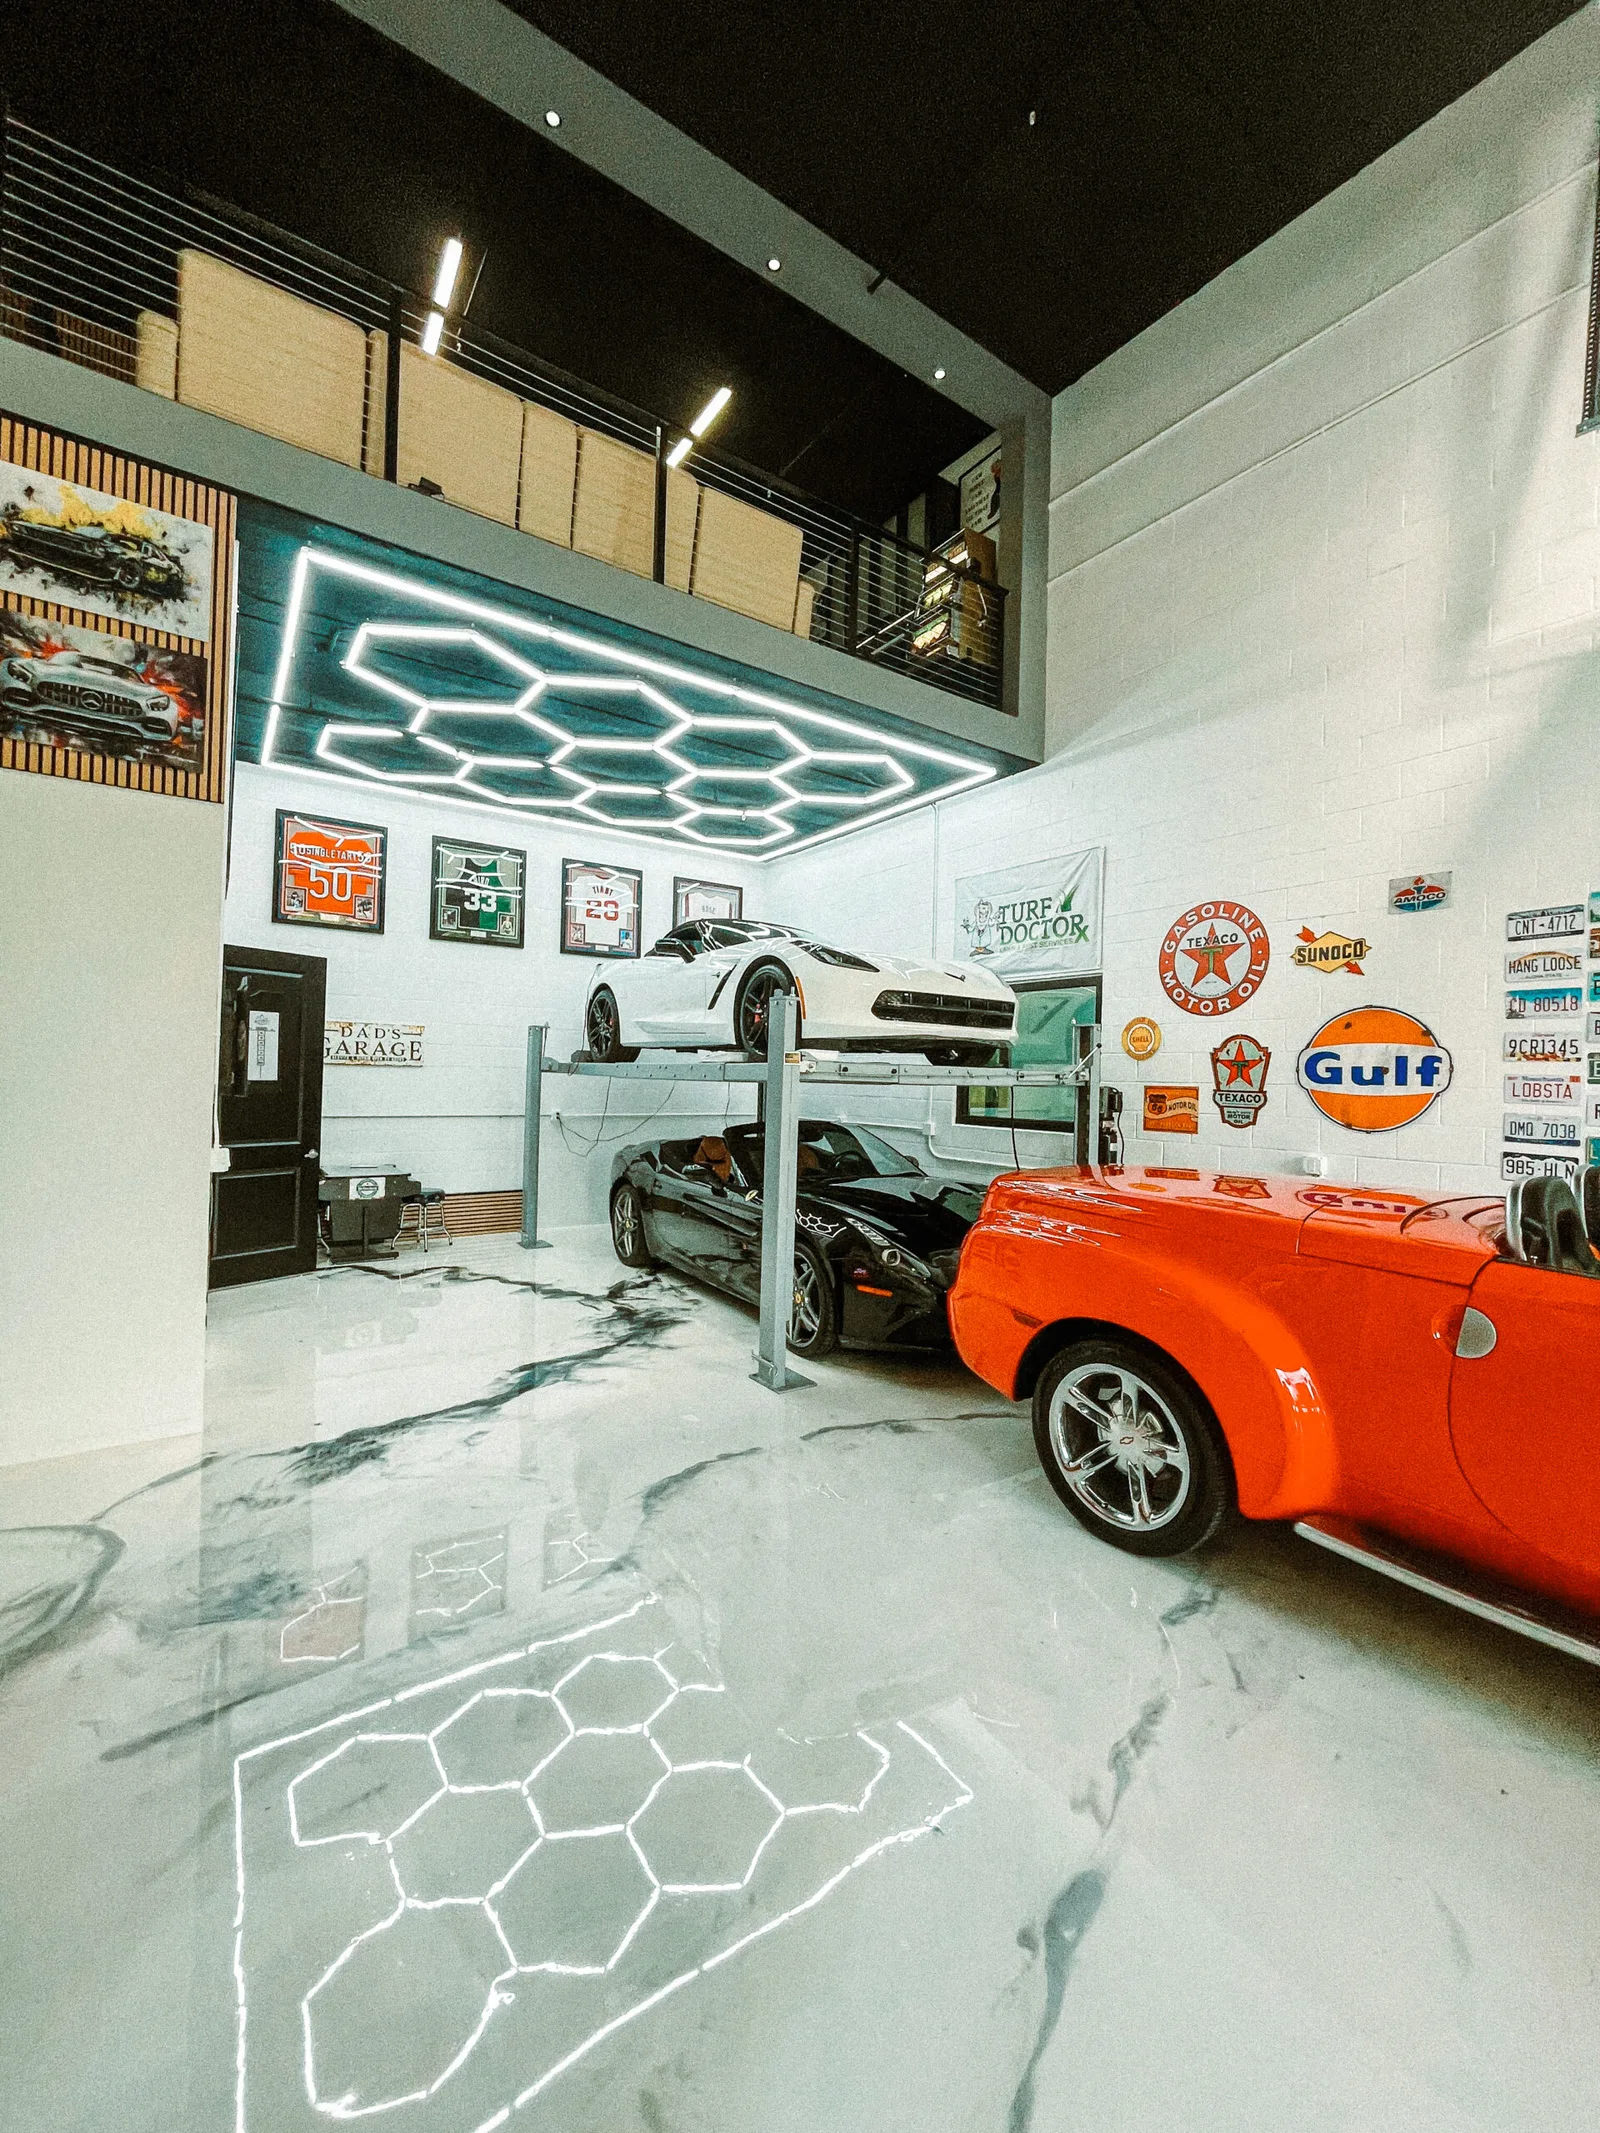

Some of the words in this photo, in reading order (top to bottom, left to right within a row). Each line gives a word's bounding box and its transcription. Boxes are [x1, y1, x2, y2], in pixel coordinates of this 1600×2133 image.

[309, 863, 352, 901] 50
[463, 888, 497, 912] 33
[1393, 892, 1446, 904] AMOCO
[998, 897, 1052, 925] TURF
[1163, 904, 1265, 953] GASOLINE
[1186, 933, 1239, 948] TEXACO
[1297, 941, 1364, 963] SUNOCO
[1508, 959, 1538, 974] HANG
[1543, 955, 1582, 971] LOOSE
[1162, 970, 1231, 1014] MOTOR
[1238, 960, 1266, 997] OIL
[1533, 995, 1579, 1012] 80518
[341, 1026, 401, 1039] DAD'S
[1304, 1051, 1443, 1087] Gulf
[1218, 1093, 1261, 1103] TEXACO
[1512, 1082, 1573, 1100] LOBSTA
[1542, 1123, 1576, 1139] 7038
